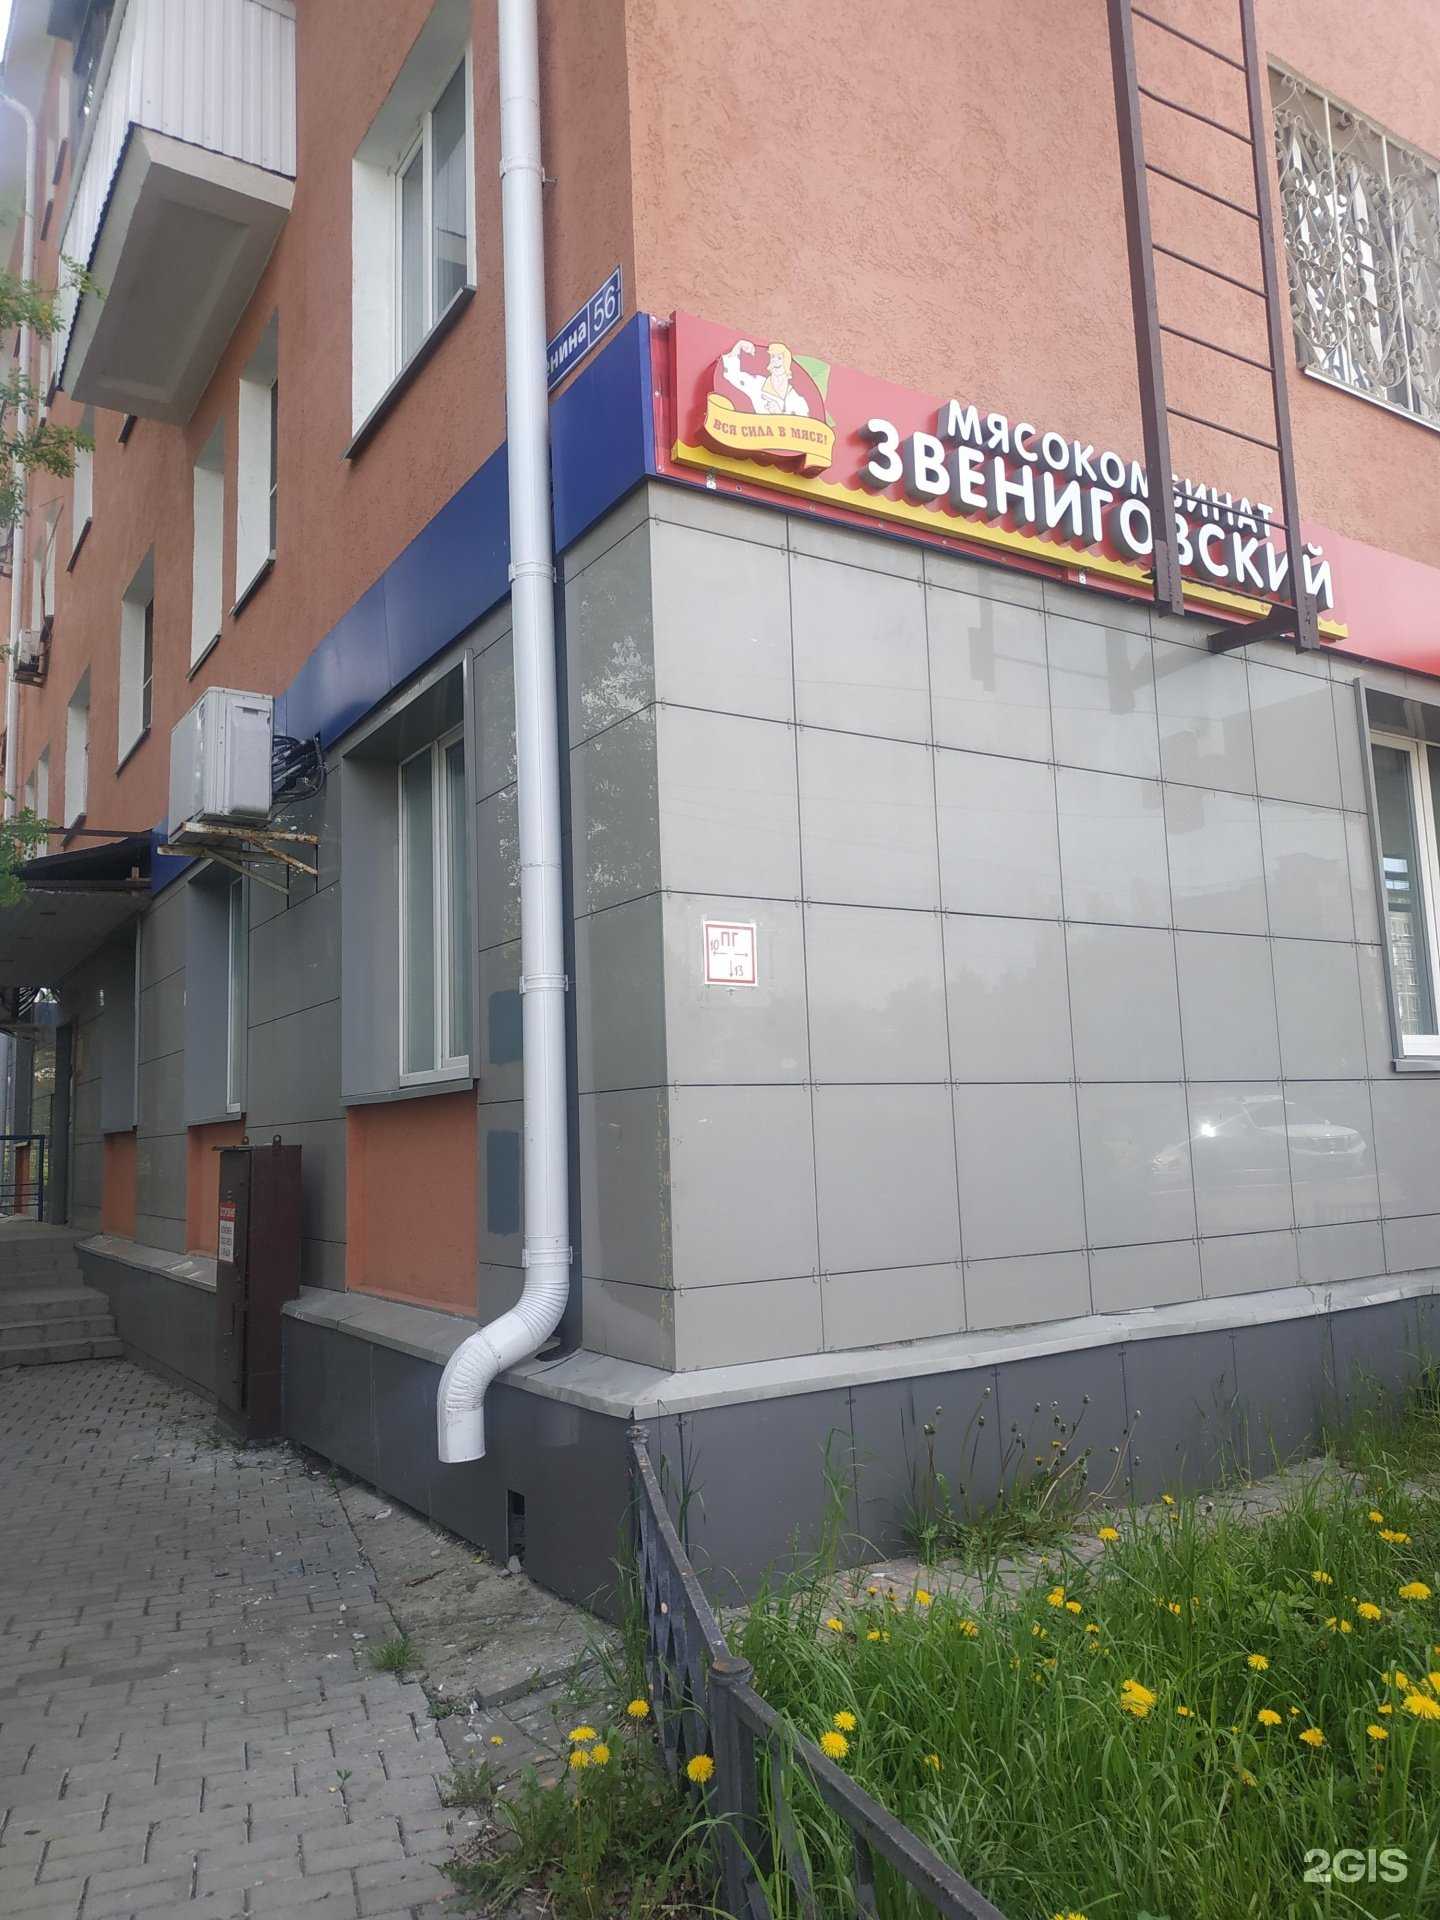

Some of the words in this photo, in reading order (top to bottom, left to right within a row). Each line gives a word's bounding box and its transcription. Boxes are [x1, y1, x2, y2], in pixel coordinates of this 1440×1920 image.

[547, 321, 587, 373] нина
[593, 286, 616, 331] 56
[713, 419, 737, 436] ВСЯ
[741, 426, 774, 438] СИЛА
[777, 426, 786, 437] В
[791, 427, 828, 444] МЯСЕ!
[720, 931, 739, 947] ПГ
